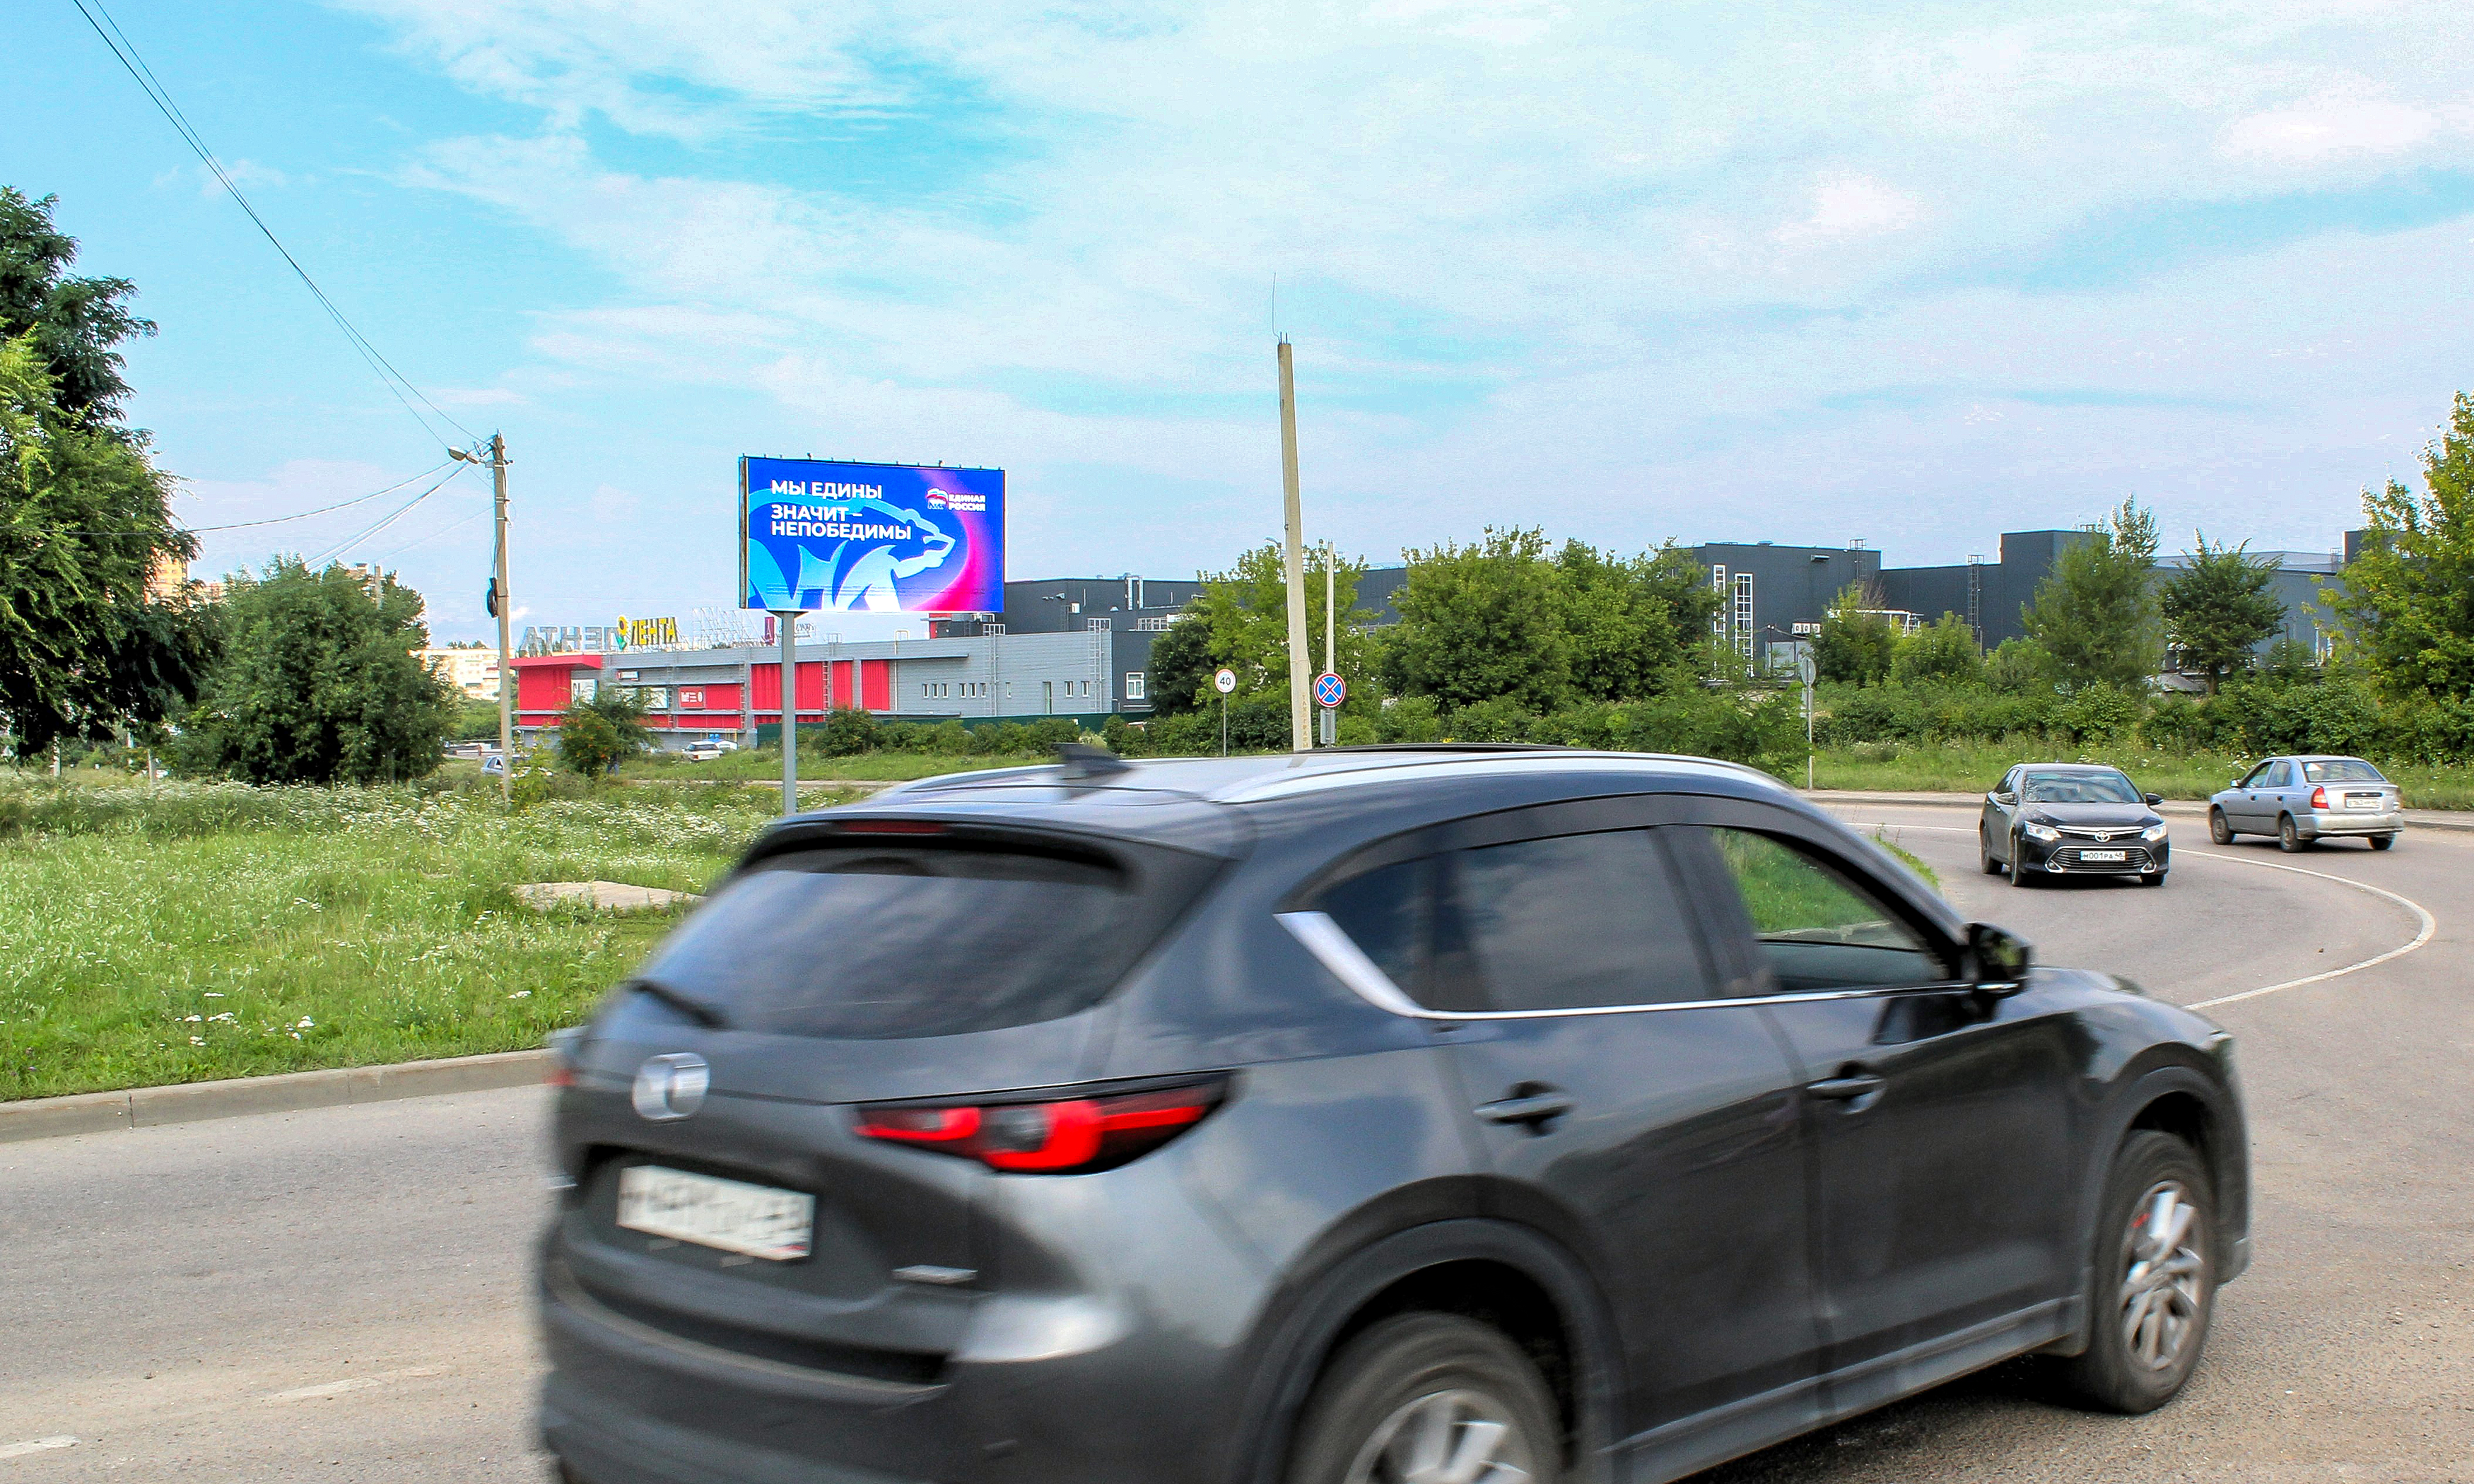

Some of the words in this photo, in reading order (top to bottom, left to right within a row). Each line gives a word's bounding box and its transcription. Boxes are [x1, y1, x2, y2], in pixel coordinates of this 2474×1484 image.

[770, 479, 806, 495] МЫ
[811, 481, 882, 500] ЕДИНЫ
[948, 494, 986, 502] ЕДИНАЯ
[770, 504, 850, 522] ЗНАЧИТ
[948, 502, 986, 511] РОССИЯ
[770, 521, 912, 541] НЕПОБЕДИМЫ
[631, 616, 679, 646] ЛЕНТА
[1219, 676, 1231, 685] 40
